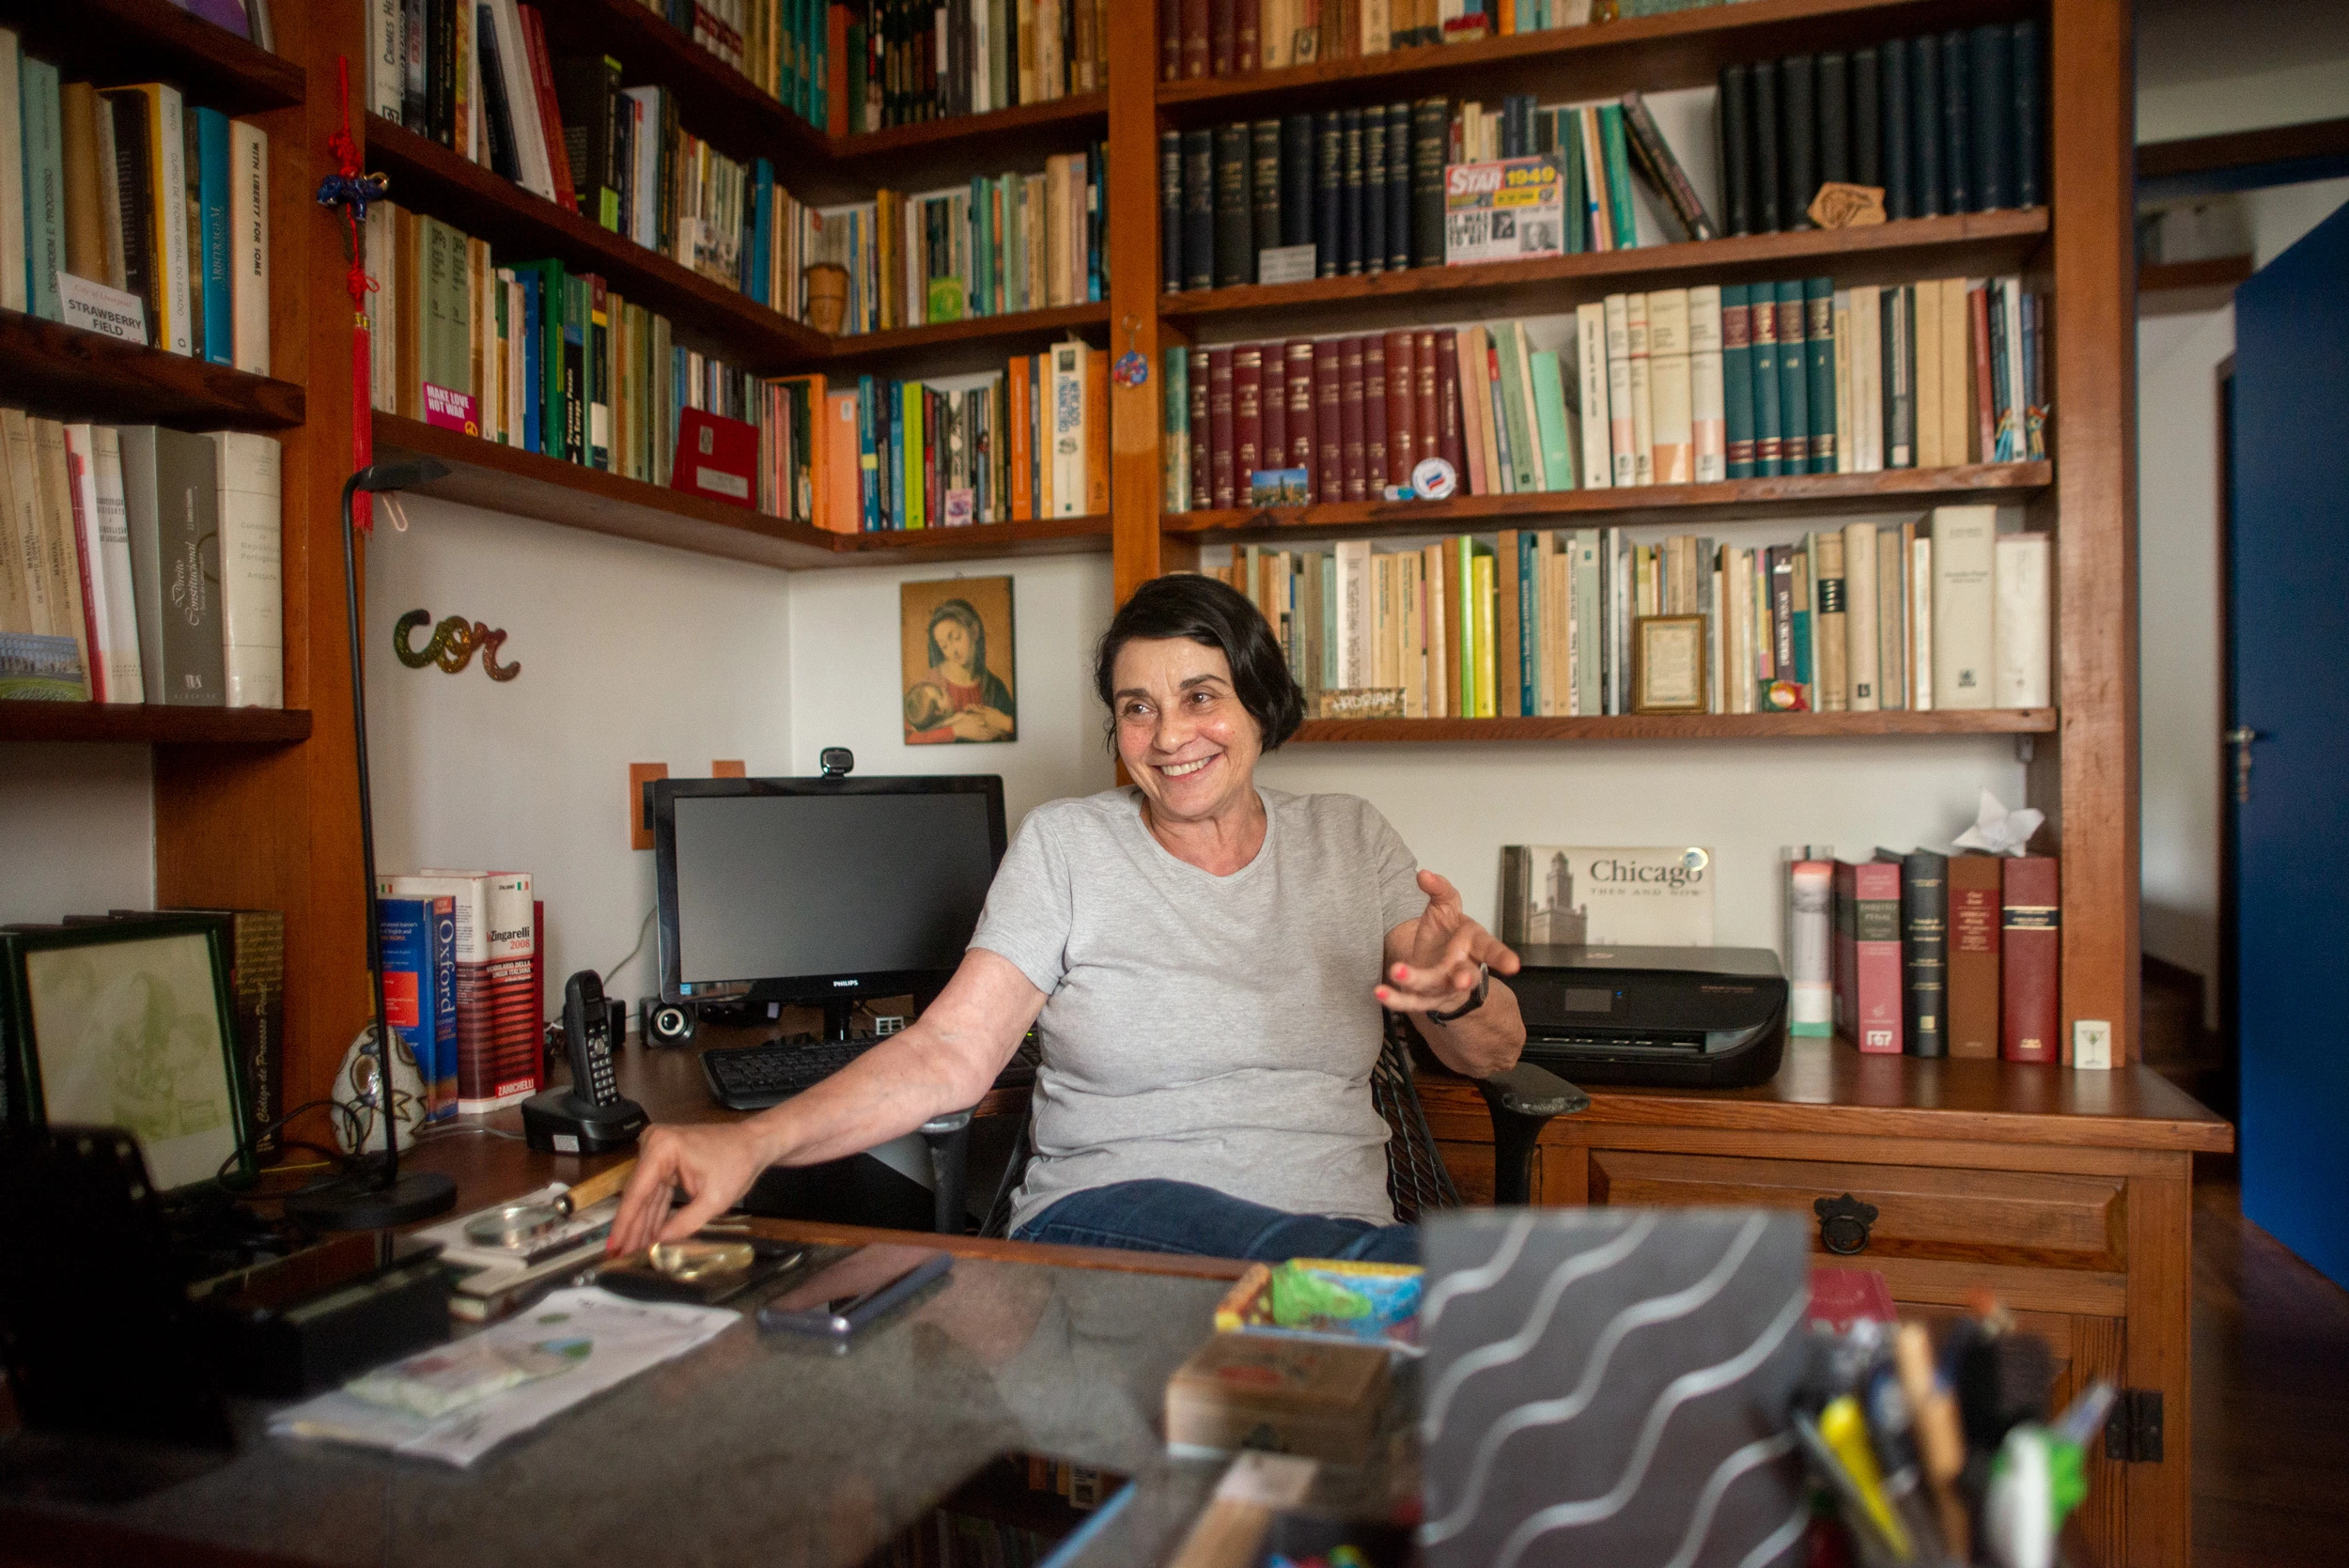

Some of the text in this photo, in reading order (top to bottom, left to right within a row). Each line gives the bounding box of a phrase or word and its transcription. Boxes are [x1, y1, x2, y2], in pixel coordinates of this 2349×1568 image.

[252, 173, 261, 217] LIBERTY
[170, 152, 179, 184] CURSO
[176, 281, 184, 316] ESTADO
[254, 248, 262, 277] SOME
[69, 298, 141, 330] STRAWBERRY
[92, 318, 124, 336] FIELD
[426, 383, 470, 410] MAKE LOVE
[428, 396, 465, 420] NOT WAR
[172, 559, 185, 609] Direito
[184, 541, 200, 627] Constitucional
[1590, 860, 1703, 889] Chicago
[510, 939, 531, 950] 2008
[439, 919, 456, 1016] Oxford
[832, 979, 859, 987] PHILIPS
[497, 1078, 535, 1097] ZANICHELLI
